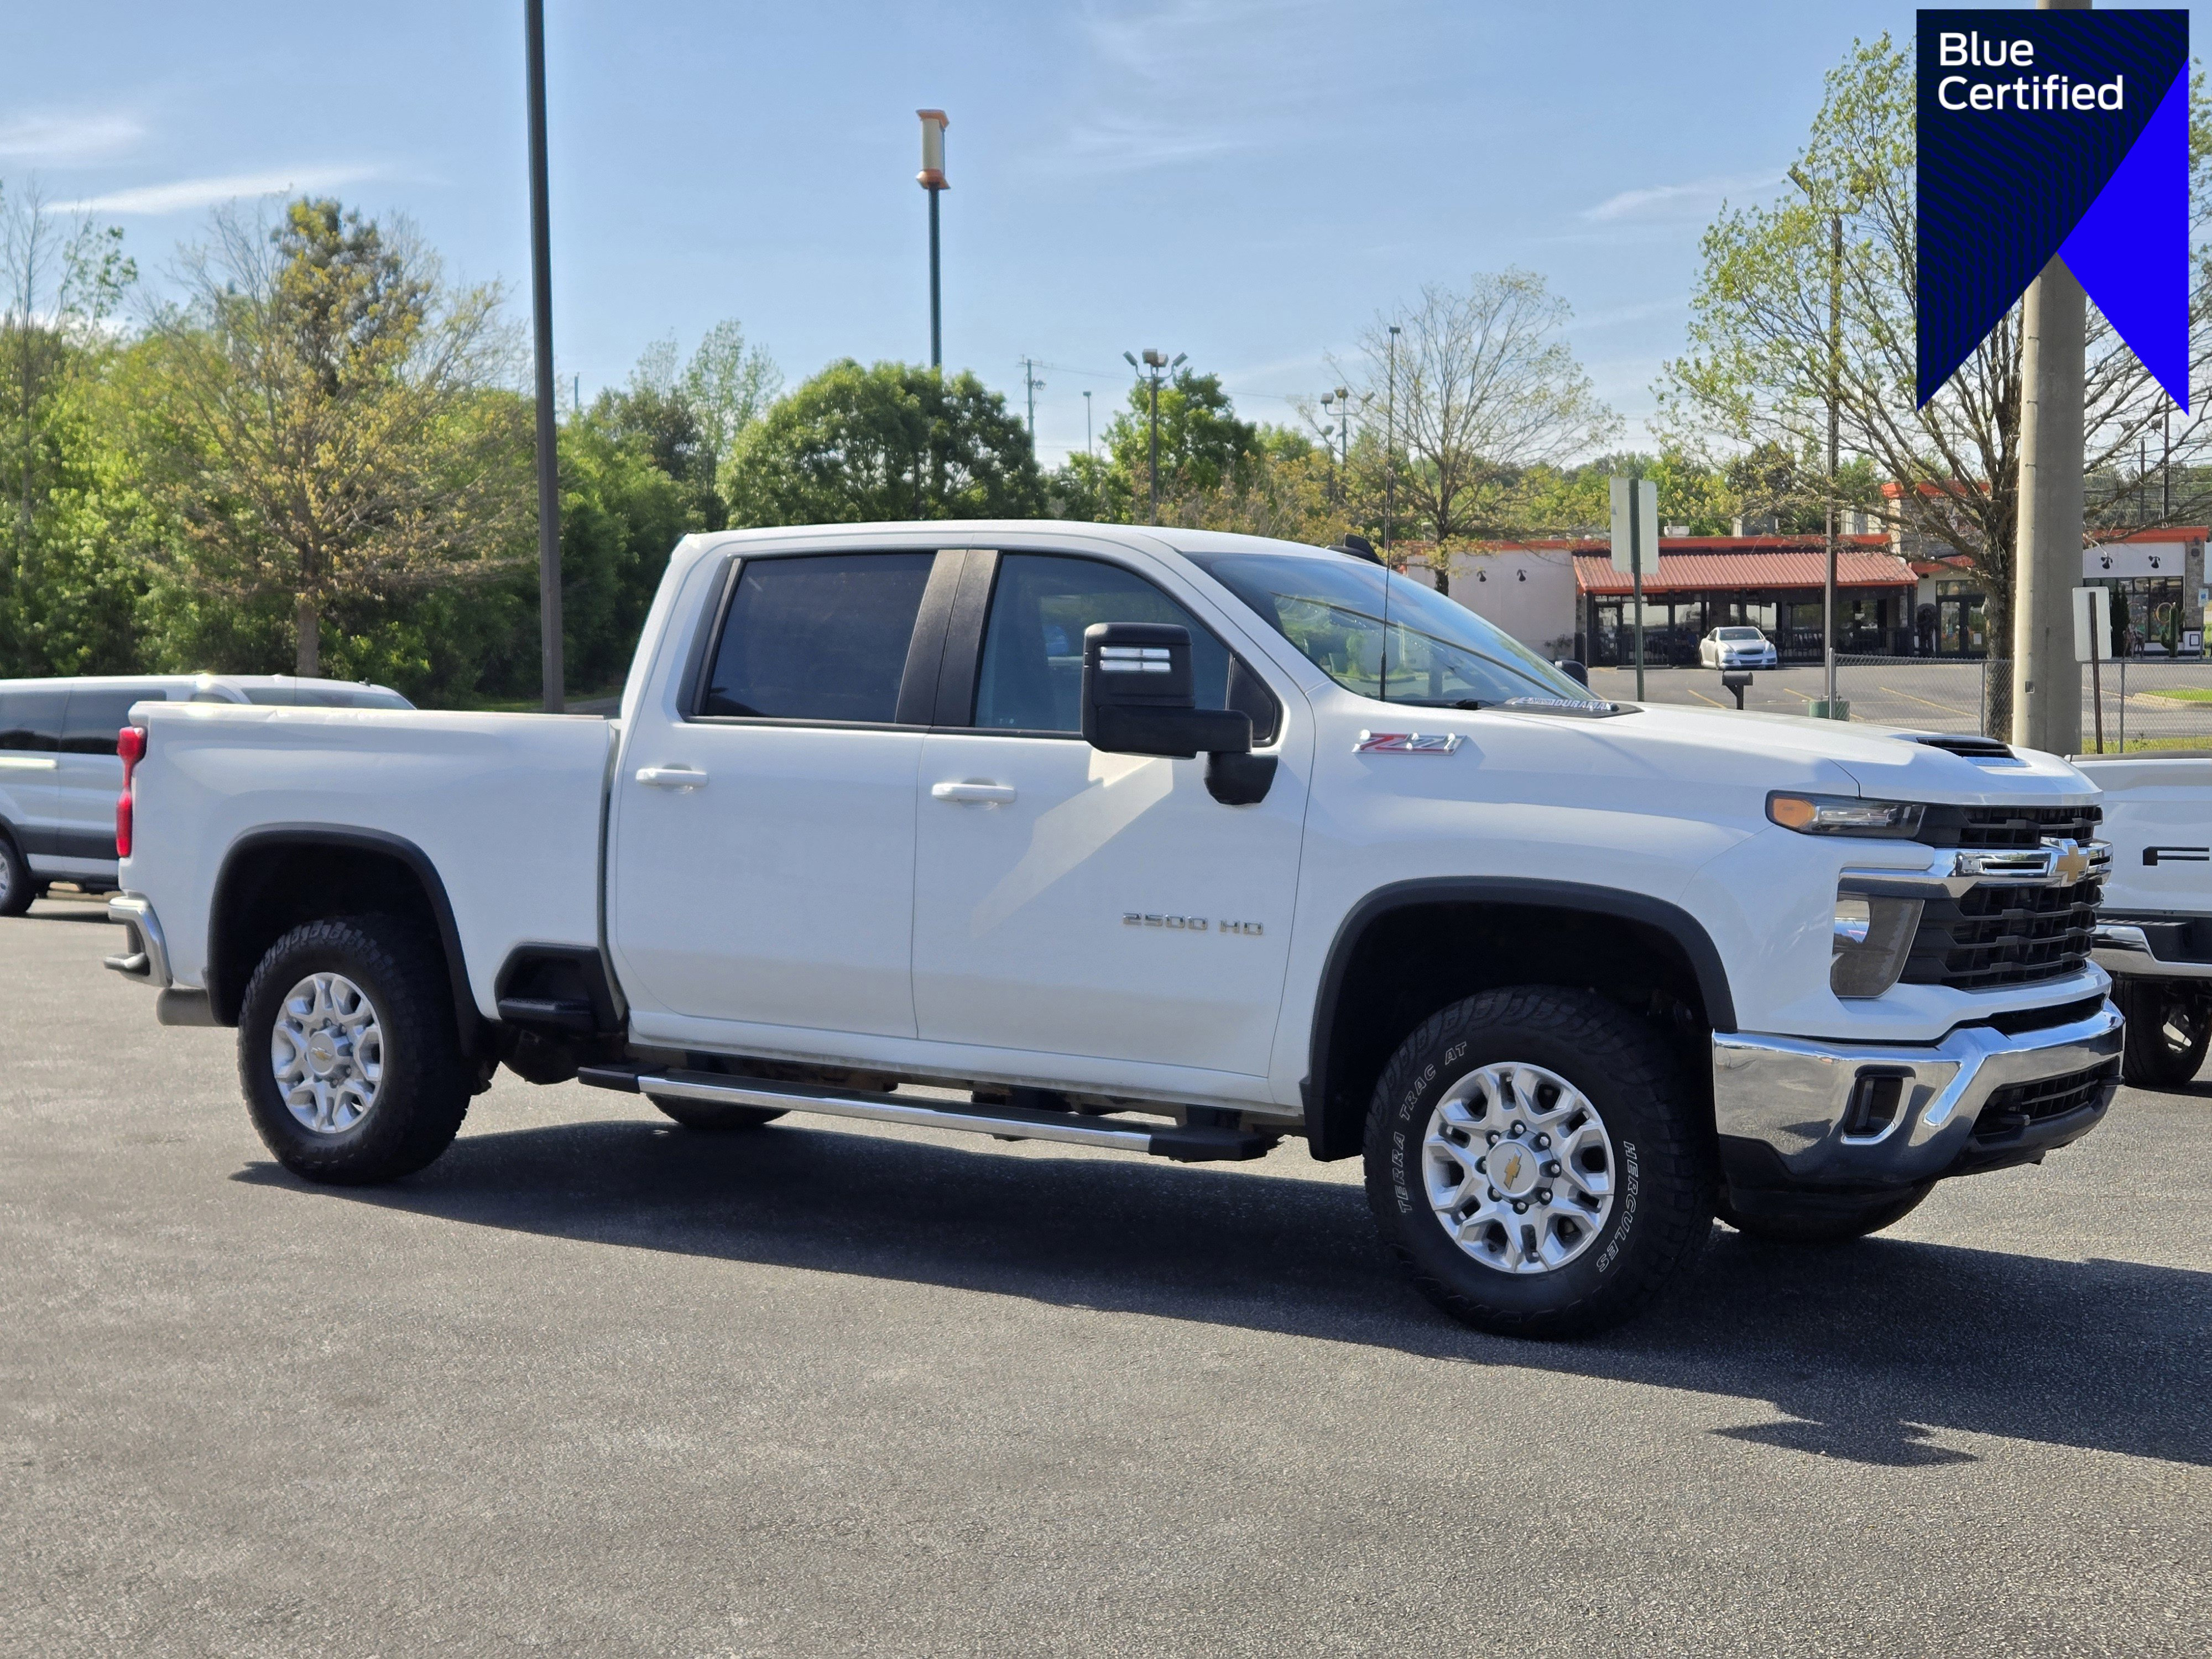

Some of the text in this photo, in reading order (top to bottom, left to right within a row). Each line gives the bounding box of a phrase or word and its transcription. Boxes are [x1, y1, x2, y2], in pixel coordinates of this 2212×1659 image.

[1554, 699, 1614, 711] DURAMAX
[1123, 912, 1264, 936] 2500 HD
[1391, 1041, 1467, 1214] TERRA TRAC AT
[1596, 1141, 1639, 1272] HERCULES
